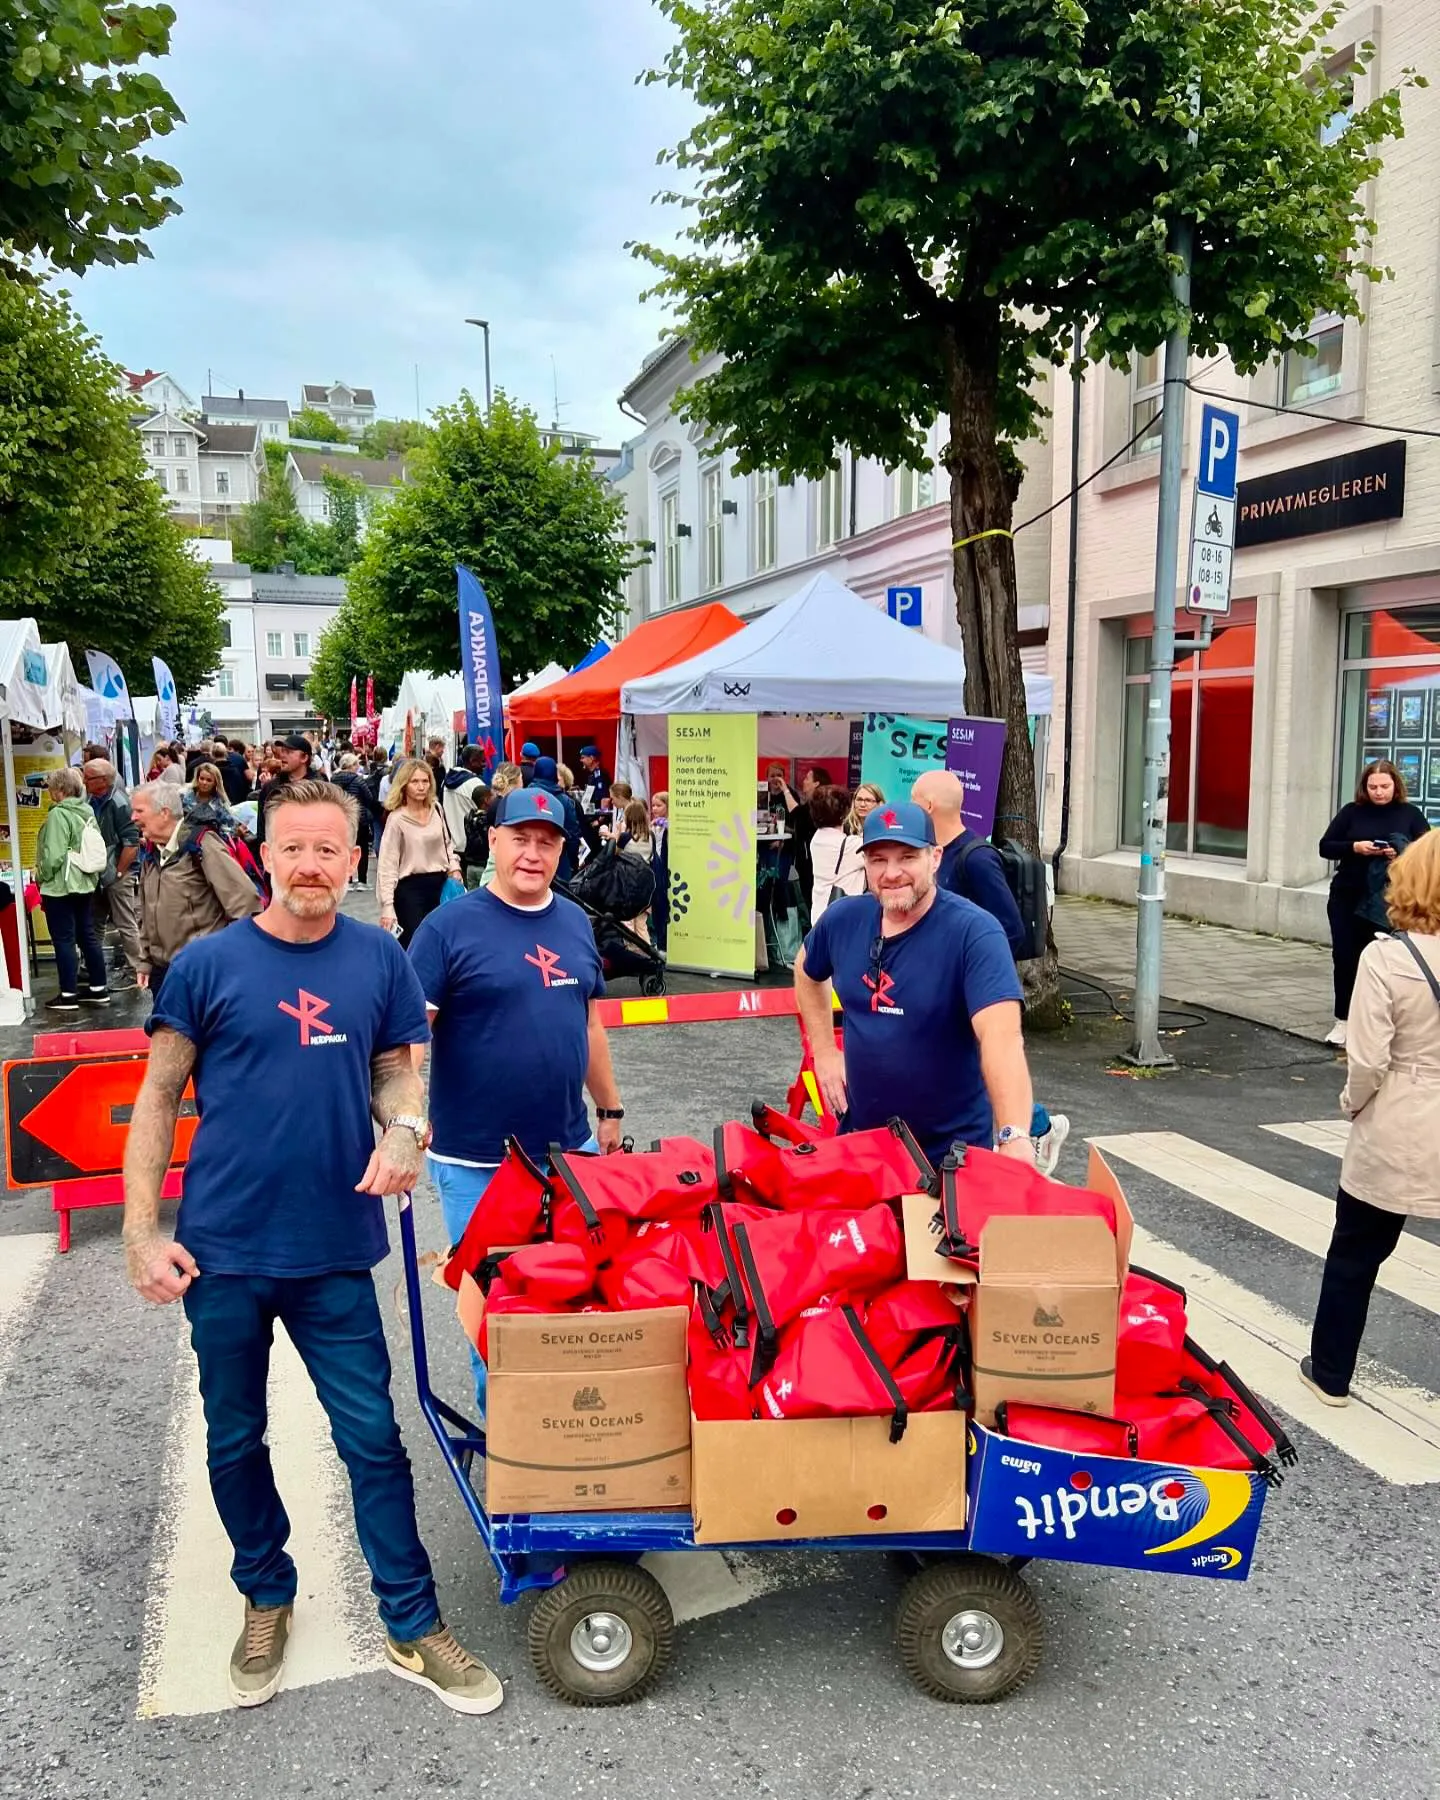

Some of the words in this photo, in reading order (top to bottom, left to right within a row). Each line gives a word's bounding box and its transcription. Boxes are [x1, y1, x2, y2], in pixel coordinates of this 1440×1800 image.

[1206, 417, 1231, 483] P
[1239, 472, 1388, 522] PRIVATMEGLEREN
[1200, 547, 1223, 565] 08-16
[1197, 567, 1223, 586] (08-15)
[895, 592, 914, 622] P
[675, 727, 711, 738] SESAM
[675, 754, 704, 763] Hvorfor
[675, 767, 695, 776] noen
[696, 766, 728, 776] demens,
[675, 778, 696, 787] mens
[697, 777, 719, 787] andre
[675, 788, 687, 797] har
[688, 788, 705, 797] frisk
[706, 788, 732, 800] hjerne
[675, 799, 692, 809] livet
[693, 799, 706, 809] ut?
[1014, 1478, 1180, 1540] Bendit
[1191, 1553, 1228, 1568] Bendit
